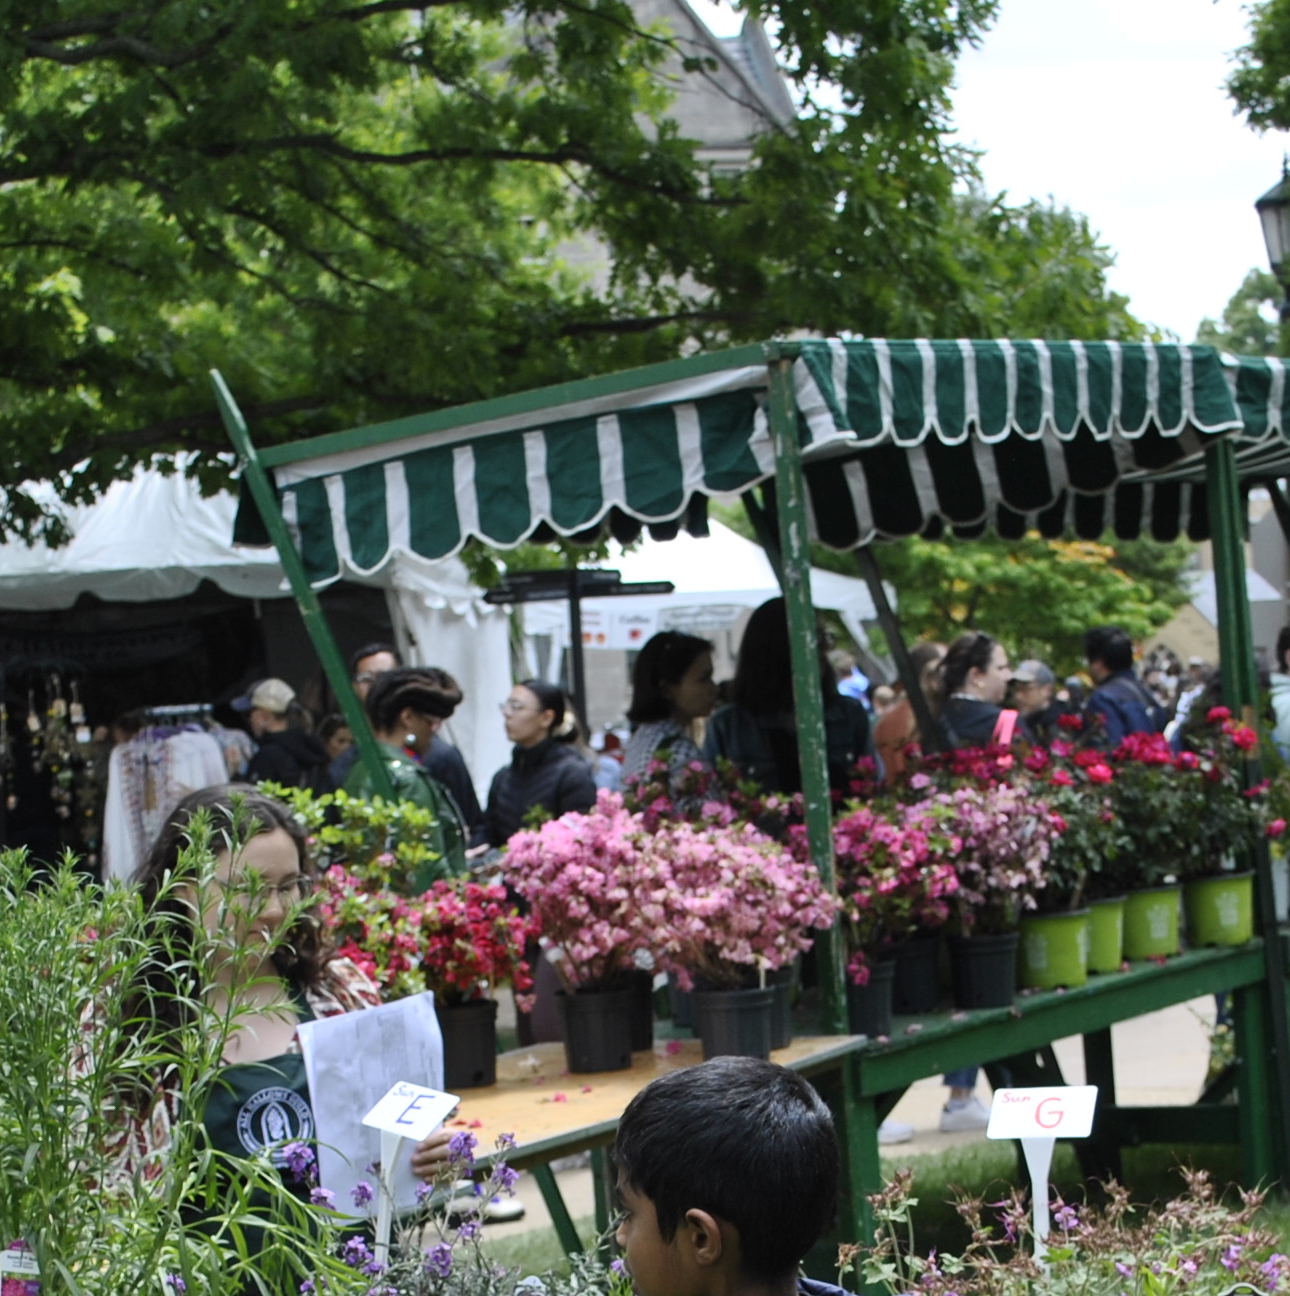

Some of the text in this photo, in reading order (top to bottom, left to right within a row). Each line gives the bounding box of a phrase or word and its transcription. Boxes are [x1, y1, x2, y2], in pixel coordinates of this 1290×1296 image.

[395, 1094, 437, 1125] E
[1001, 1091, 1031, 1104] Sun
[1034, 1096, 1064, 1129] G
